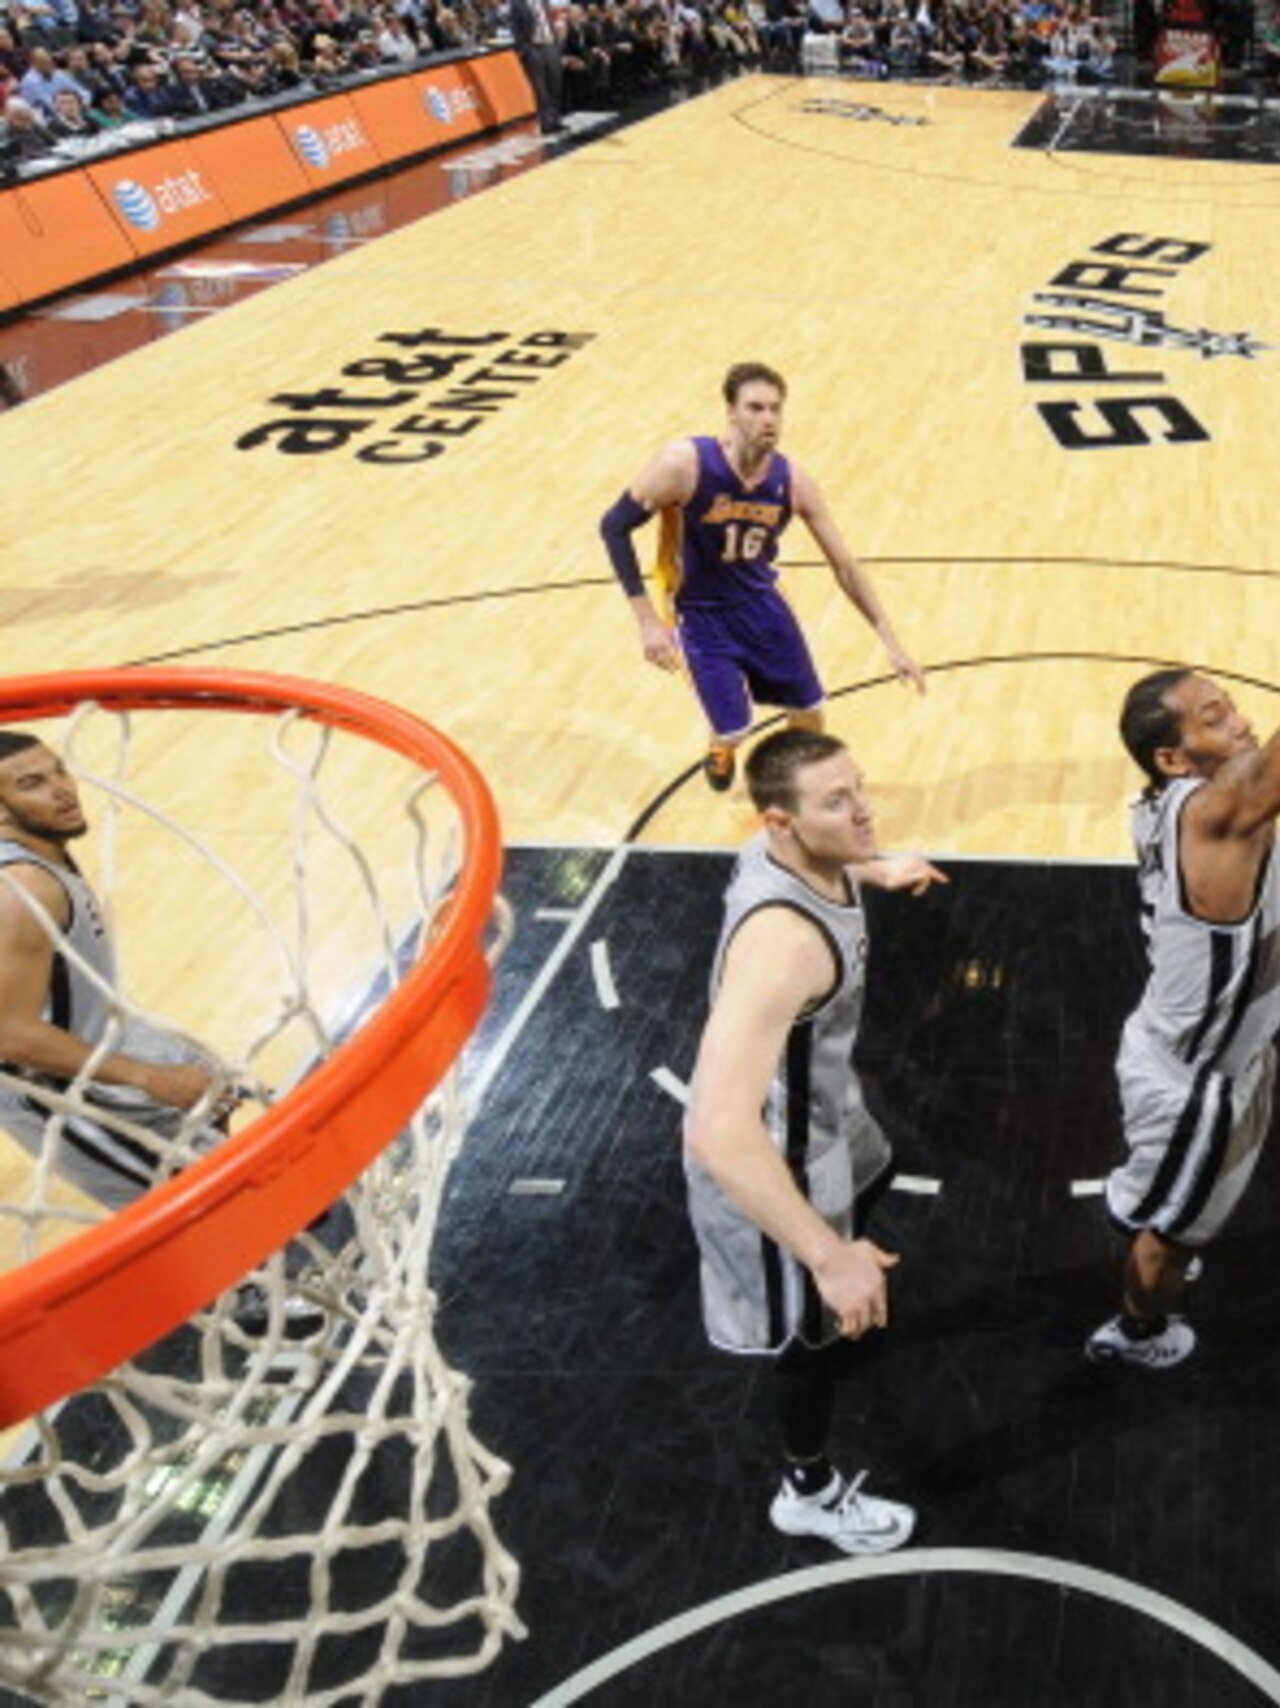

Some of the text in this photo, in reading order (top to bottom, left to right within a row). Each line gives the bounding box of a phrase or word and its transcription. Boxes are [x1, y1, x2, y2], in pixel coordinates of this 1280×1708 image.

[234, 328, 512, 455] at&t
[354, 331, 599, 465] CENTER
[1018, 232, 1255, 450] SPURS
[721, 523, 768, 563] 16
